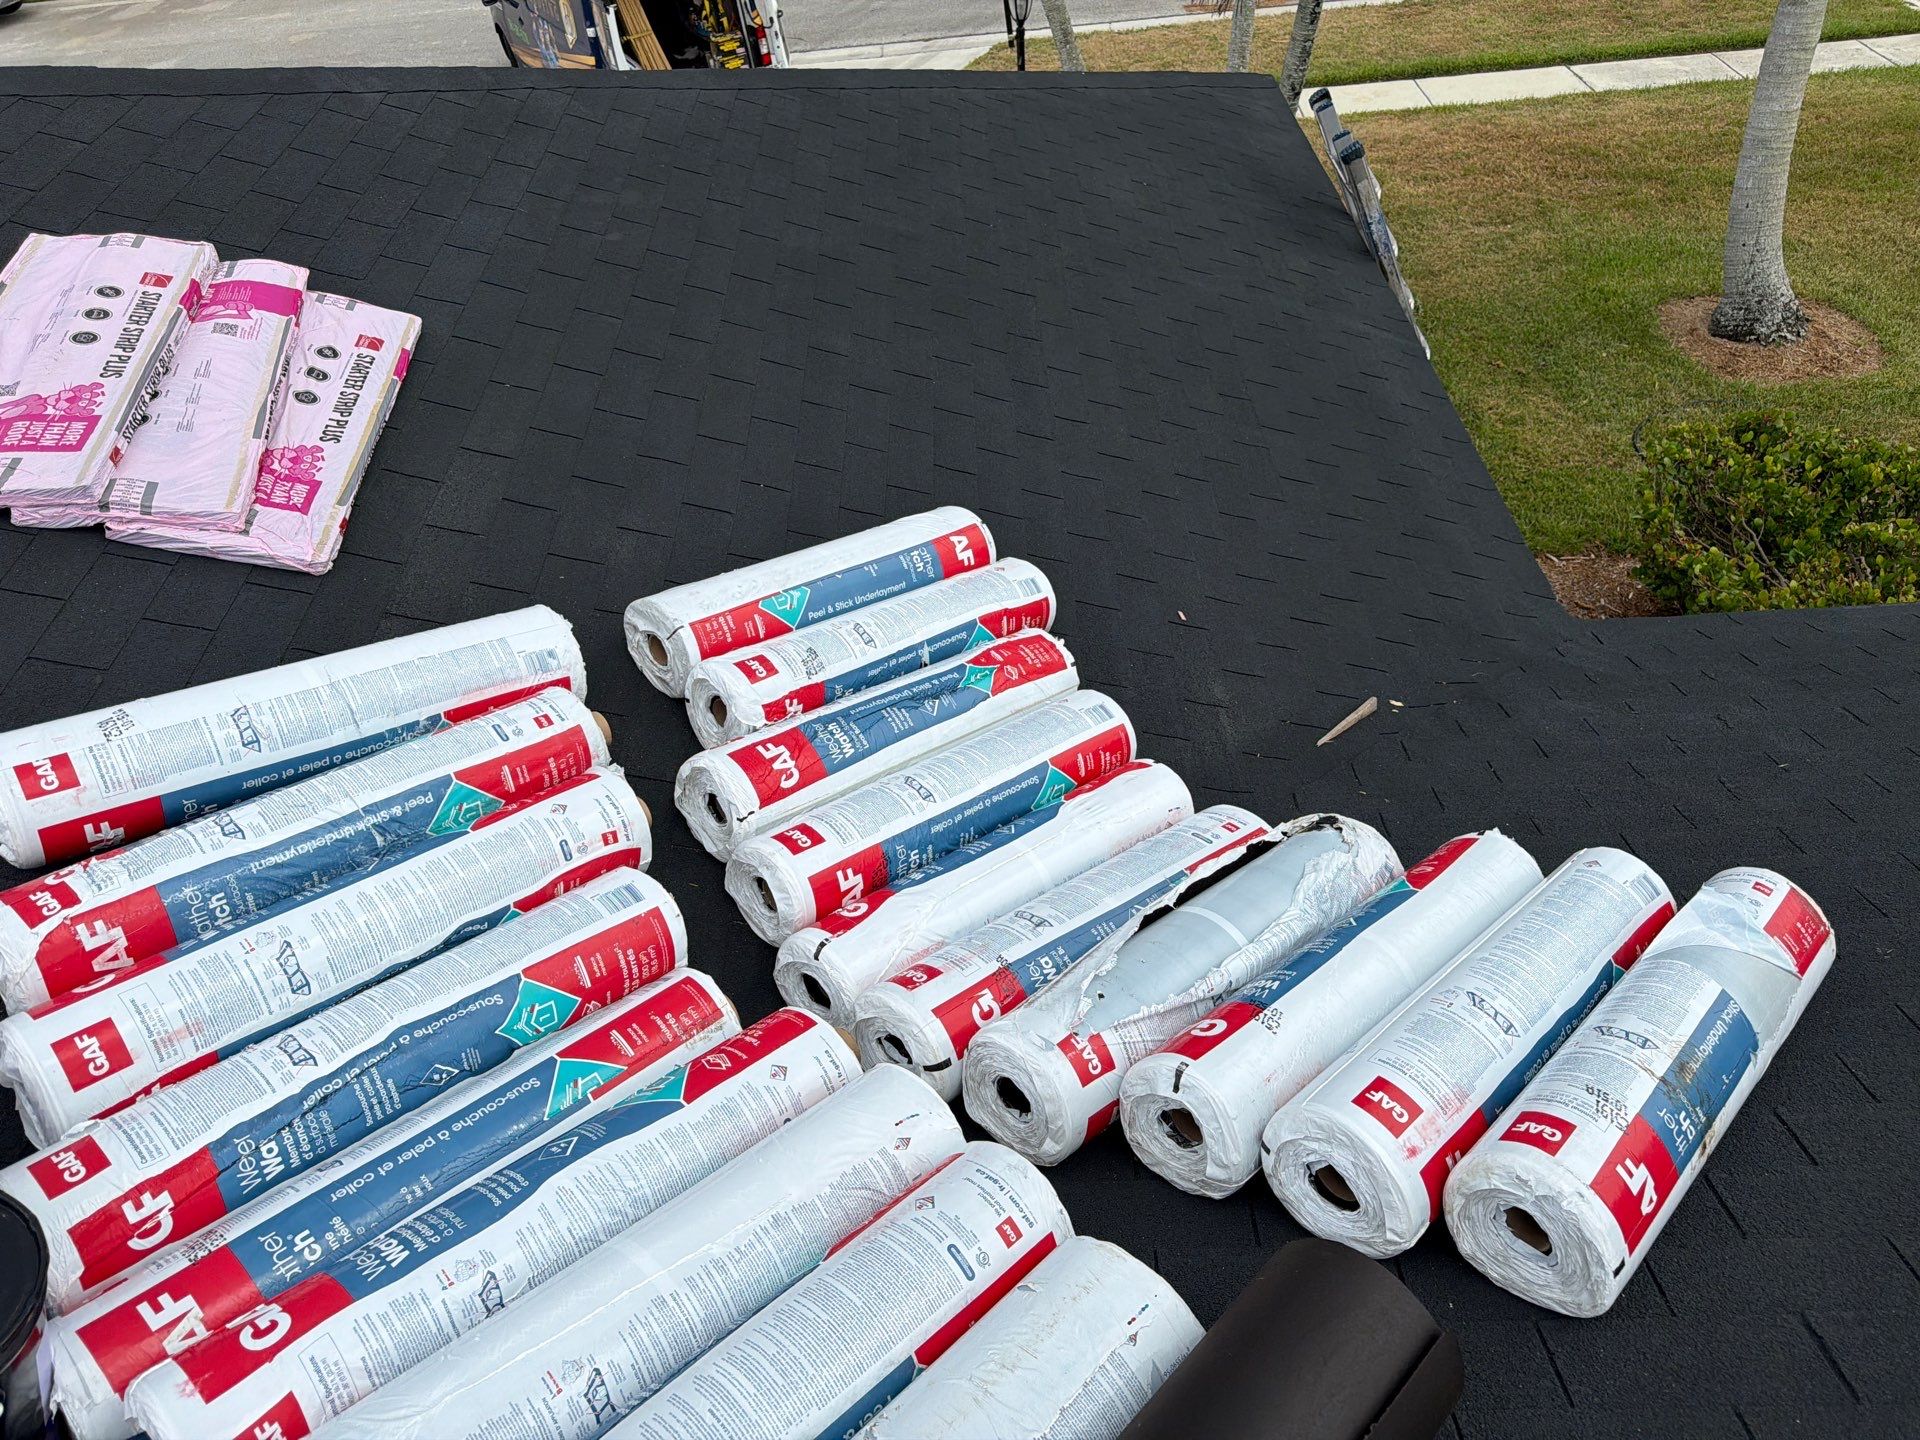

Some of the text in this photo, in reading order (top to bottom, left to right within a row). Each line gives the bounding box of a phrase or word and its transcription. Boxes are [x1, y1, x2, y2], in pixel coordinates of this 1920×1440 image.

[100, 290, 162, 379] STARTER STRIP PLUS
[319, 352, 375, 444] STARTER STRIP PLUS
[24, 422, 48, 438] JUST
[38, 422, 67, 446] THAN
[59, 422, 88, 446] MORE
[270, 480, 292, 504] THAN
[911, 550, 924, 571] tch
[919, 547, 935, 578] ather
[950, 536, 975, 566] AF
[808, 581, 906, 621] Peel & Stick Underlayment
[719, 616, 732, 642] quares
[927, 631, 968, 652] Sous-couch
[745, 659, 767, 677] GAF
[867, 662, 888, 677] coller
[889, 659, 897, 667] et
[898, 651, 917, 664] peler
[939, 672, 959, 682] Peel
[850, 690, 912, 715] Underlayment
[812, 723, 844, 764] Weather
[828, 722, 855, 758] Watch
[282, 768, 295, 780] et
[298, 756, 330, 773] peler
[548, 757, 560, 785] quares
[755, 742, 800, 789] GAF
[241, 773, 278, 790] coller
[991, 775, 1039, 803] Sous-couche
[405, 792, 434, 812] Peel
[963, 801, 985, 819] peler
[930, 819, 953, 834] coller
[954, 813, 963, 823] et
[249, 825, 355, 874] Underlayment
[784, 830, 812, 847] GAF
[29, 890, 62, 916] GAF
[836, 867, 869, 918] GAF
[186, 886, 212, 934] ather
[210, 892, 232, 926] tch
[626, 948, 640, 979] carrés
[414, 993, 504, 1038] Sous-couche
[1721, 1000, 1740, 1024] Stick
[399, 1034, 410, 1044] à
[627, 1028, 642, 1045] Surface
[73, 1034, 110, 1076] GAF
[825, 1049, 843, 1079] fr.gaf.ca
[1680, 1018, 1728, 1084] Underlayment
[303, 1078, 343, 1110] coller
[451, 1077, 541, 1132] Sous-couche
[1365, 1090, 1409, 1124] GAF
[291, 1117, 313, 1160] d'étanch
[437, 1129, 450, 1141] à
[1511, 1121, 1564, 1142] GAF
[1657, 1108, 1687, 1156] ther
[281, 1126, 301, 1168] Membr
[397, 1136, 436, 1165] peler
[51, 1151, 87, 1182] GAF
[233, 1134, 262, 1194] Weer
[377, 1161, 394, 1176] et
[330, 1172, 375, 1203] coller
[976, 1168, 1005, 1192] fr.gaf.ca
[977, 1185, 999, 1204] matters
[978, 1193, 997, 1210] protect
[997, 1201, 1006, 1214] what
[1009, 1195, 1035, 1229] gaf.com
[1001, 1222, 1020, 1245] GAF
